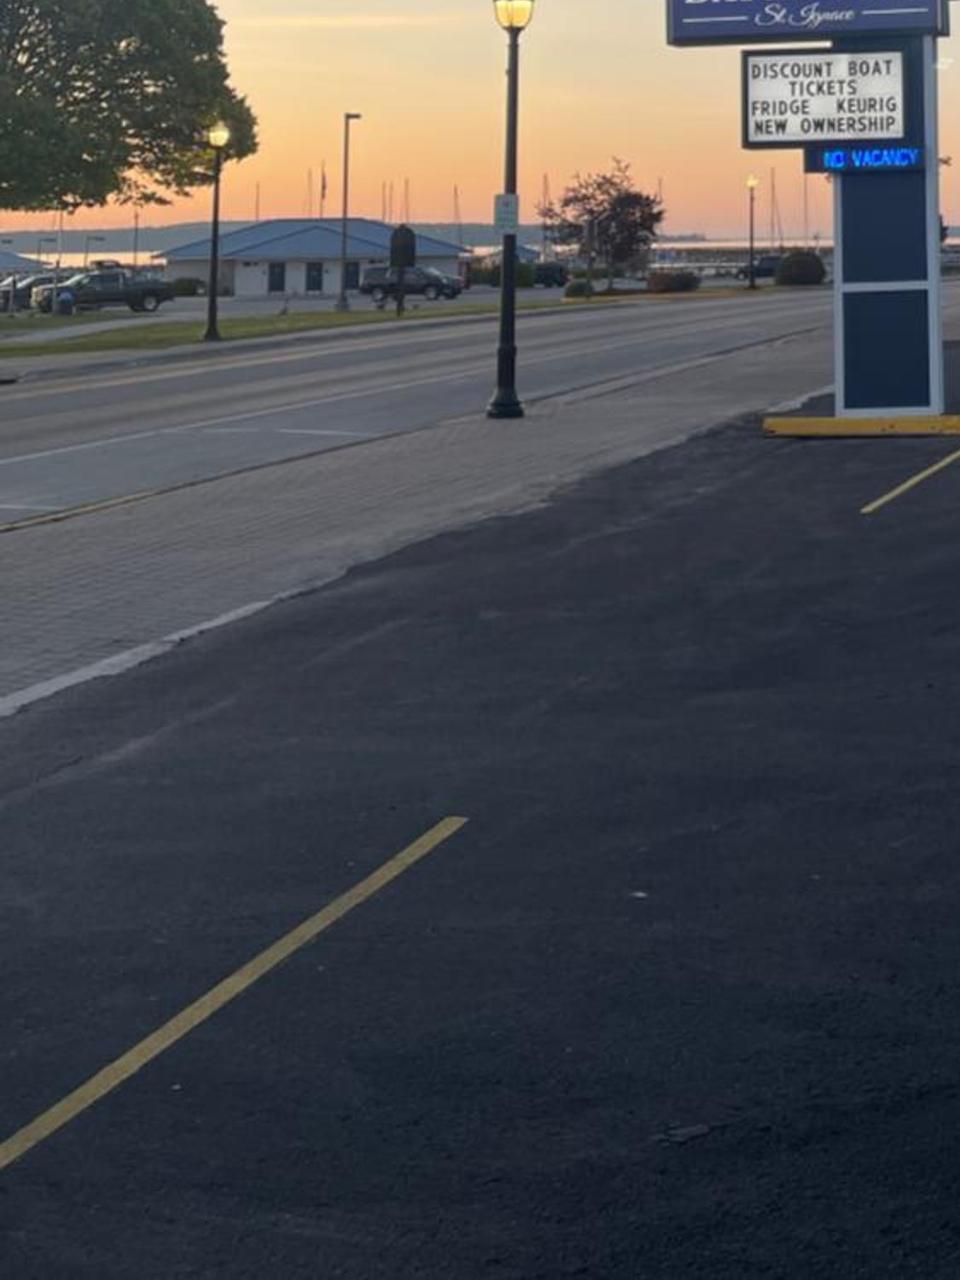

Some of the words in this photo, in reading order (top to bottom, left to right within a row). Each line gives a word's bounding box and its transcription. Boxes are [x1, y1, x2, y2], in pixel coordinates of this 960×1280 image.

[788, 2, 854, 28] Ignace
[751, 62, 833, 80] DISCOUNT
[848, 60, 893, 76] BOAT
[789, 79, 857, 97] TICKETS
[751, 99, 810, 116] FRIDGE
[836, 97, 897, 113] KEURIG
[754, 118, 788, 135] NEW
[800, 115, 896, 134] OWNERSHIP
[823, 151, 845, 168] NO
[851, 148, 919, 167] VACANCY
